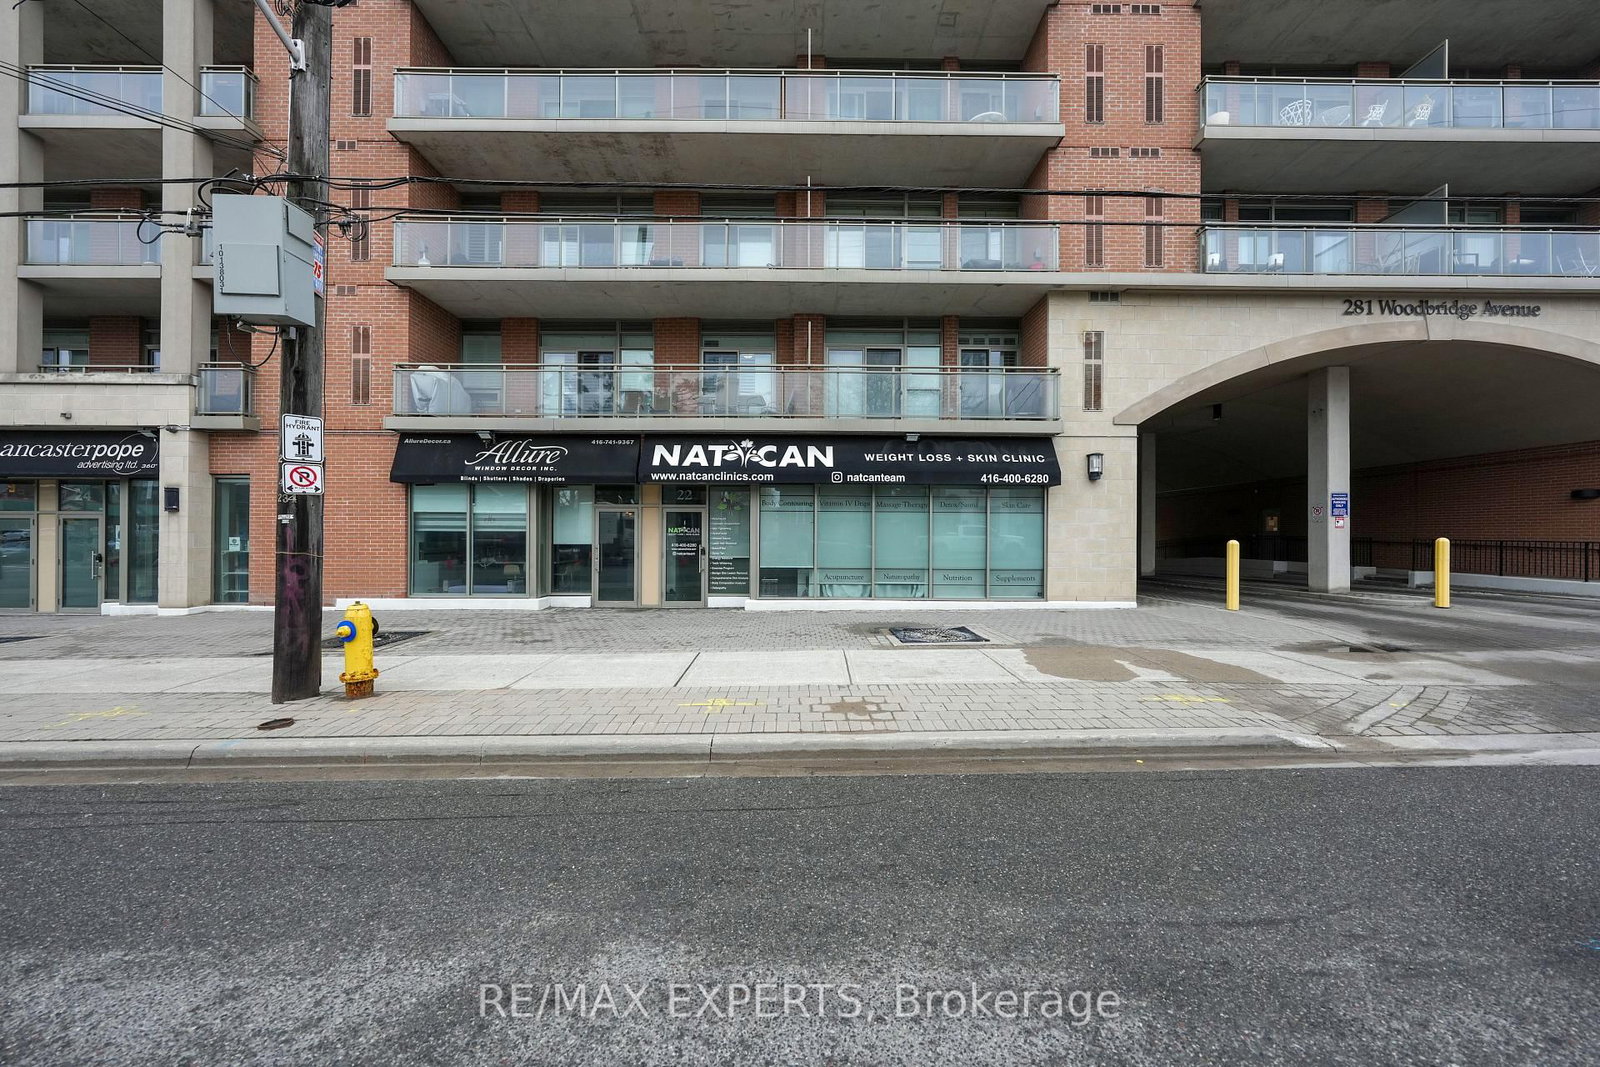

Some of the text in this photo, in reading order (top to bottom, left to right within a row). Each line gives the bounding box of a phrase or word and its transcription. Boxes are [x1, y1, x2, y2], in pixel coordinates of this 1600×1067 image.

[1343, 299, 1541, 320] 281 Woodbridge Avenue
[286, 423, 320, 432] HYDRANT
[464, 438, 569, 465] Allure
[864, 453, 914, 462] WEIGHT
[919, 453, 952, 462] LOSS
[967, 454, 998, 463] SKIN
[1002, 454, 1045, 463] CLINIC
[77, 460, 138, 470] advertising ltd.
[650, 471, 774, 481] www.natcanclinics.com
[847, 473, 906, 483] natcanteam
[980, 473, 1049, 483] 416-400-6280
[676, 489, 693, 500] 22
[824, 573, 864, 581] Acupuncture
[883, 573, 921, 581] Naturopathy
[995, 574, 1036, 583] Supplements
